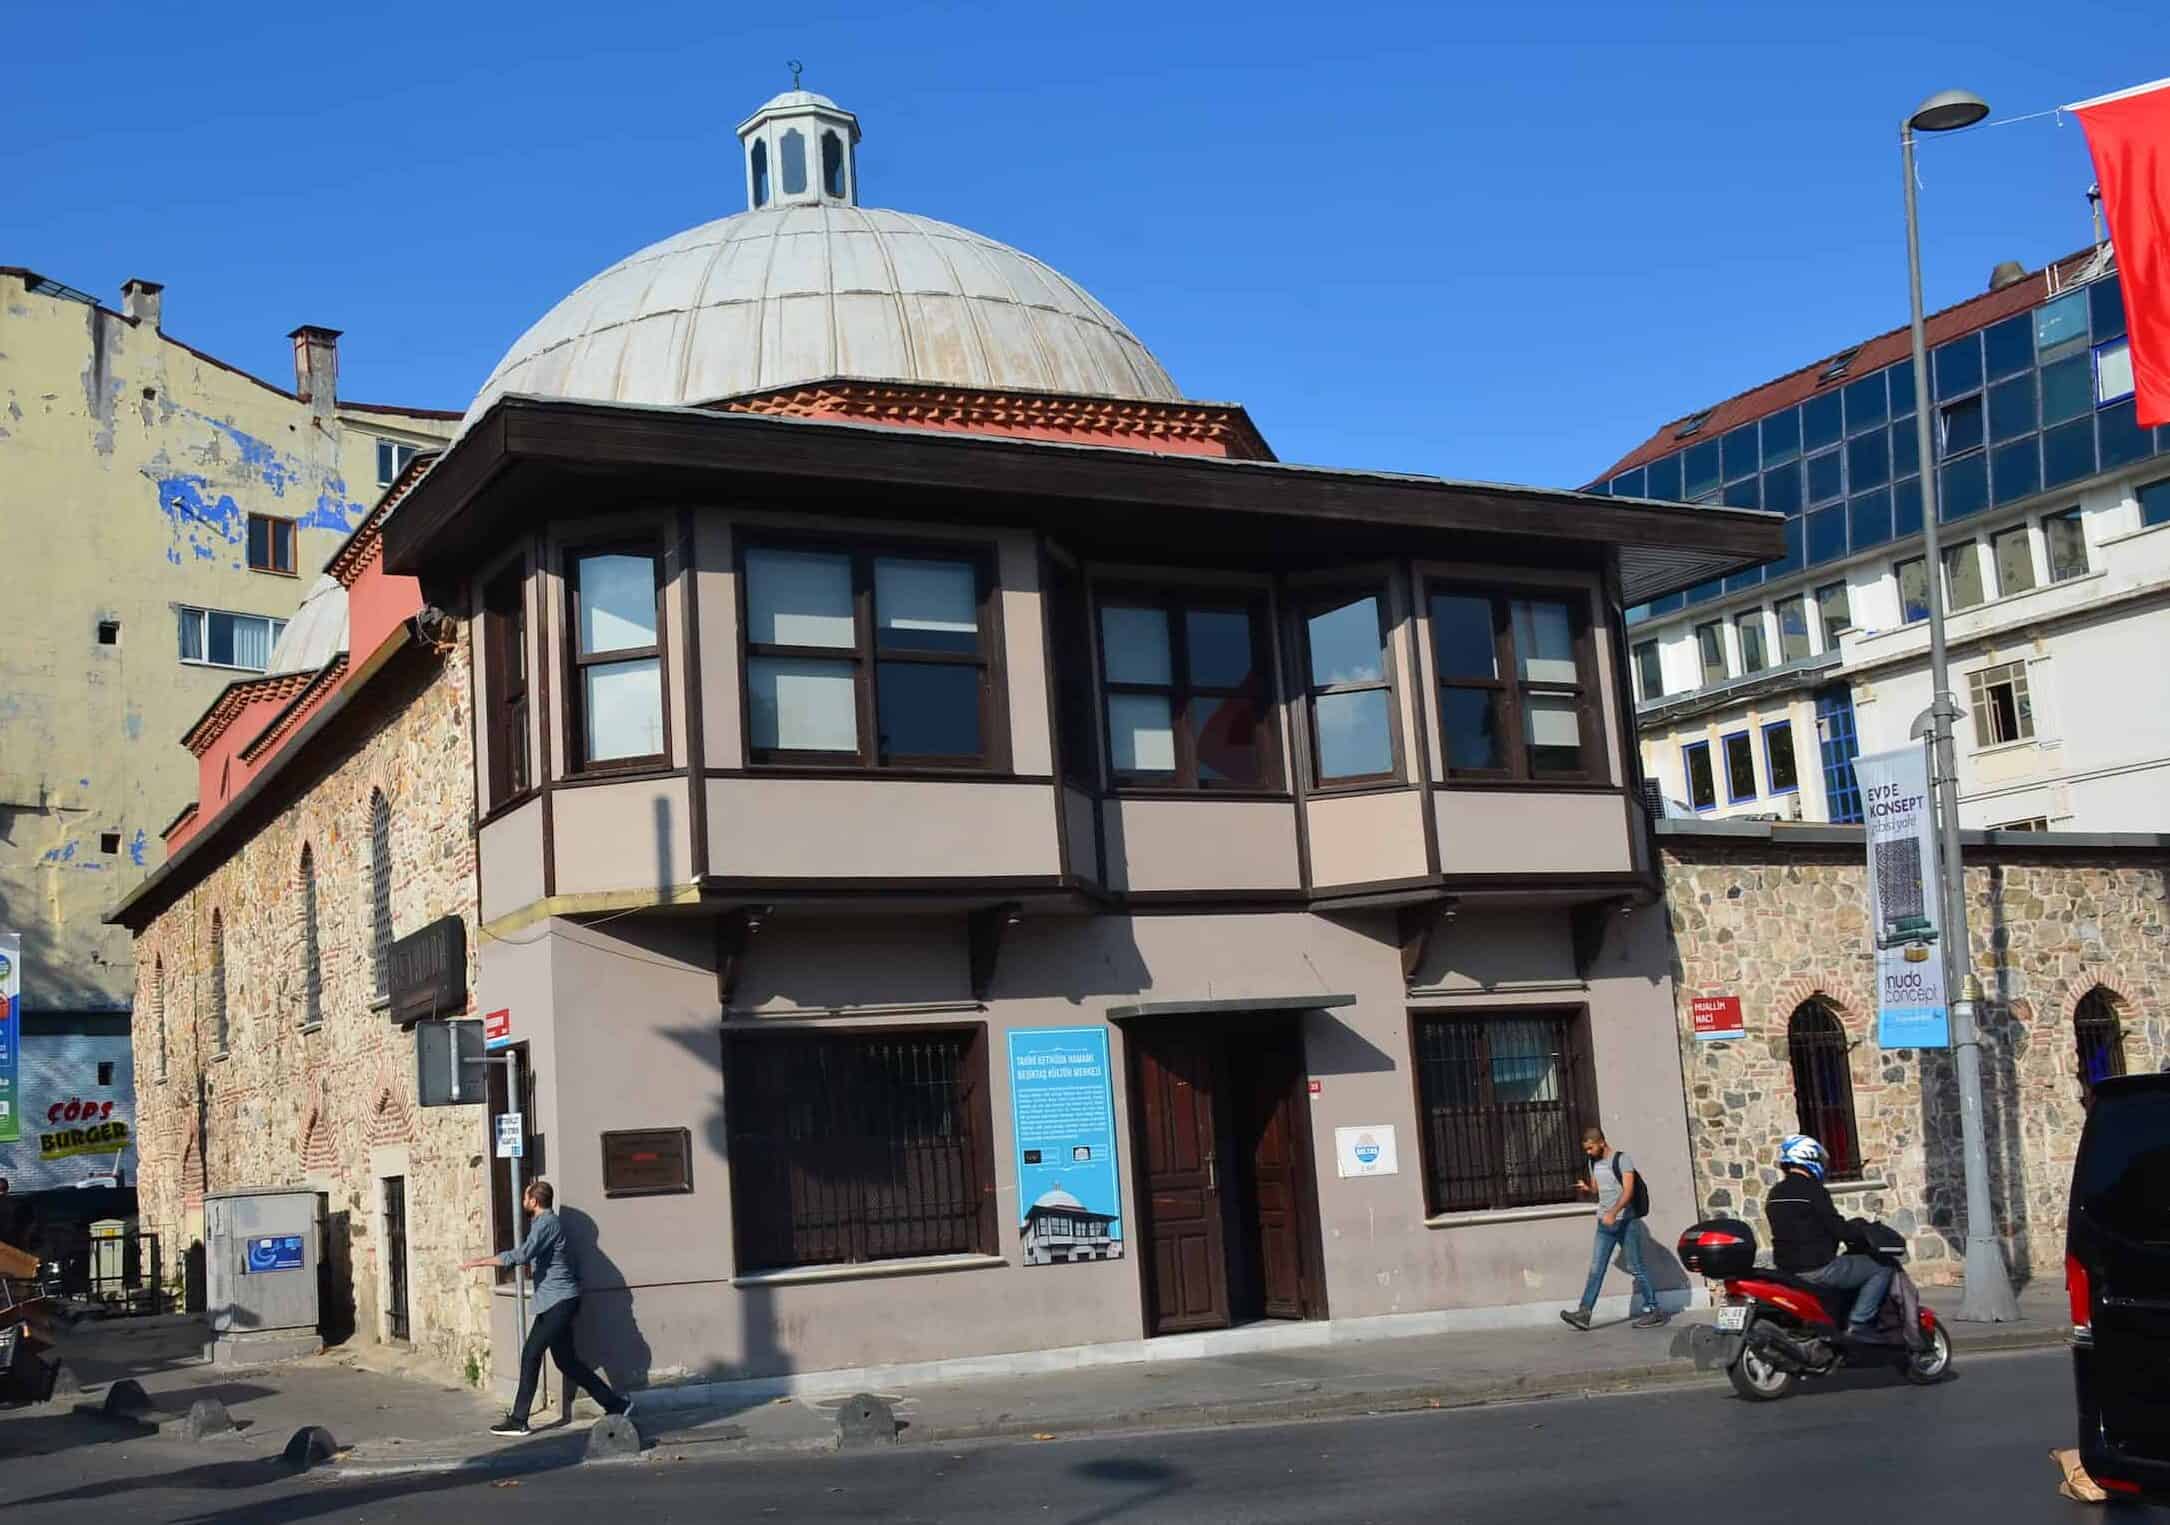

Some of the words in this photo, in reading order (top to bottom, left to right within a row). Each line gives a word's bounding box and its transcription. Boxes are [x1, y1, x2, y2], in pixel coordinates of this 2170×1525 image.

[1867, 783, 1899, 802] EVDE
[1869, 795, 1924, 819] KONSEPT
[39, 1121, 129, 1153] BURGER
